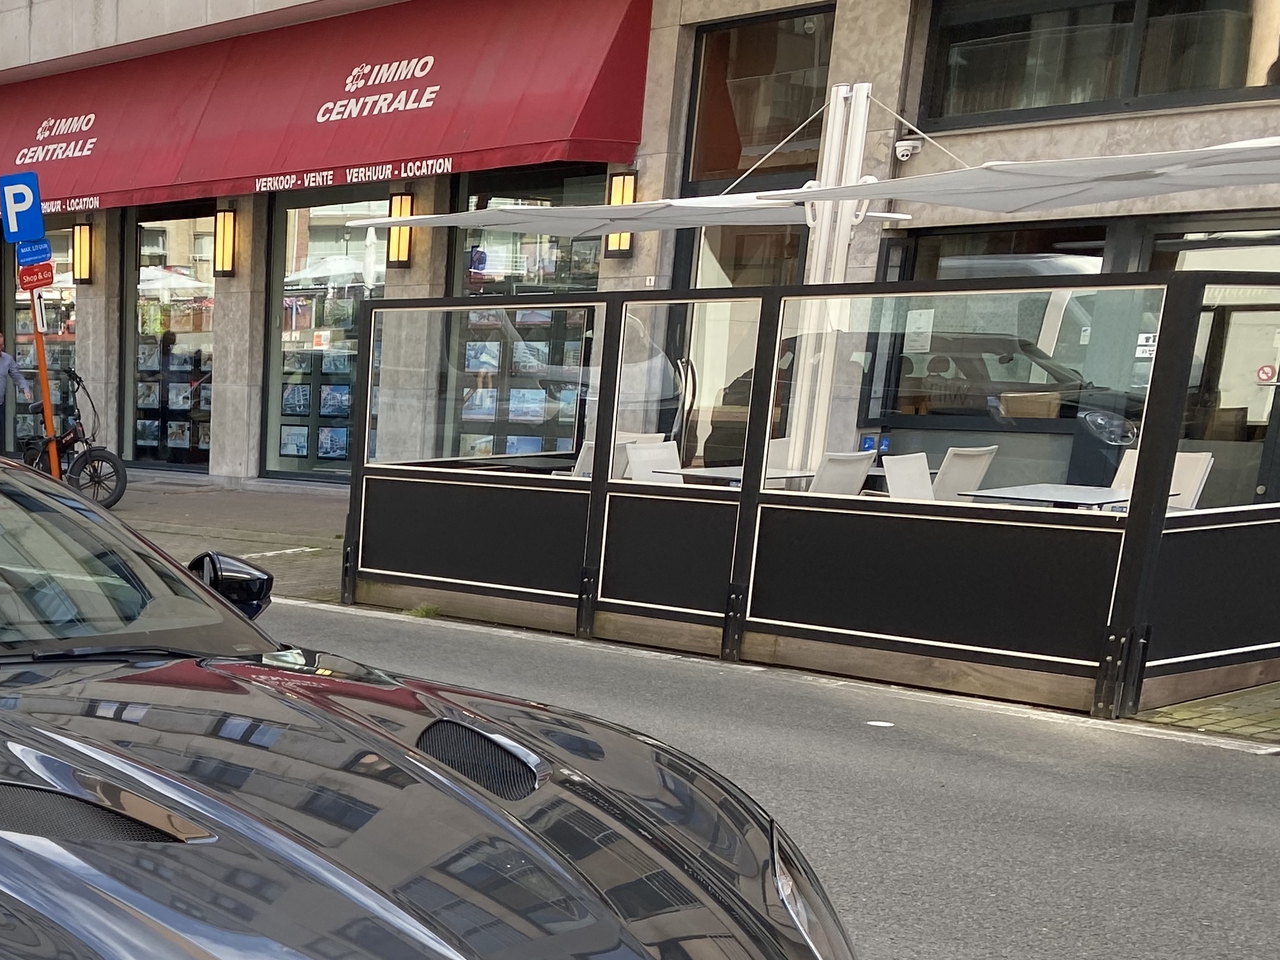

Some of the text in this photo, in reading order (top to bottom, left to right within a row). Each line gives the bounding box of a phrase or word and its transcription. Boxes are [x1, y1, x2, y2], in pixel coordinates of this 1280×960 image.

[366, 55, 435, 86] IMMO
[316, 85, 440, 123] CENTRALE
[51, 113, 96, 136] IMMO
[15, 137, 97, 165] CENTRALE
[255, 174, 297, 192] VERKOOP
[303, 170, 334, 188] VENTE
[345, 164, 393, 183] VERHUUR
[400, 157, 453, 178] LOCATION
[3, 183, 34, 233] P
[66, 196, 100, 211] LOCATION
[22, 273, 37, 284] Shop
[37, 271, 43, 280] &
[43, 270, 51, 278] Go
